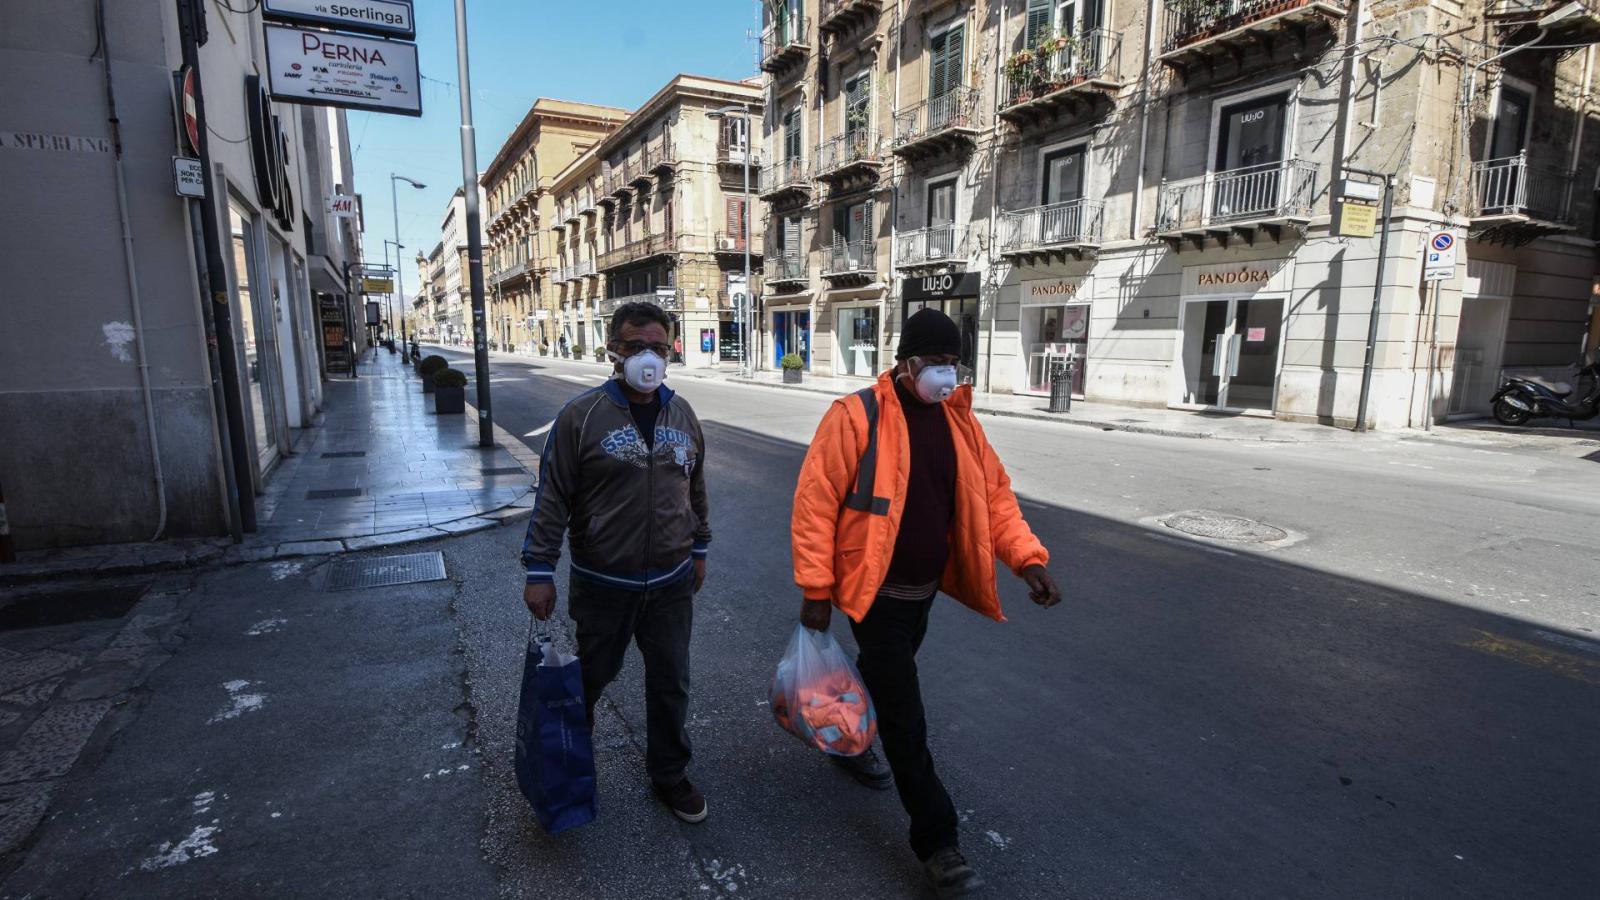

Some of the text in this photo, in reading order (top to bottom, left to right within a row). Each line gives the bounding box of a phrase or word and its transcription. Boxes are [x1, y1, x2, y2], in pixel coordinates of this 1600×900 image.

[315, 4, 403, 24] via sperlinga
[335, 87, 364, 96] SPERLINGA
